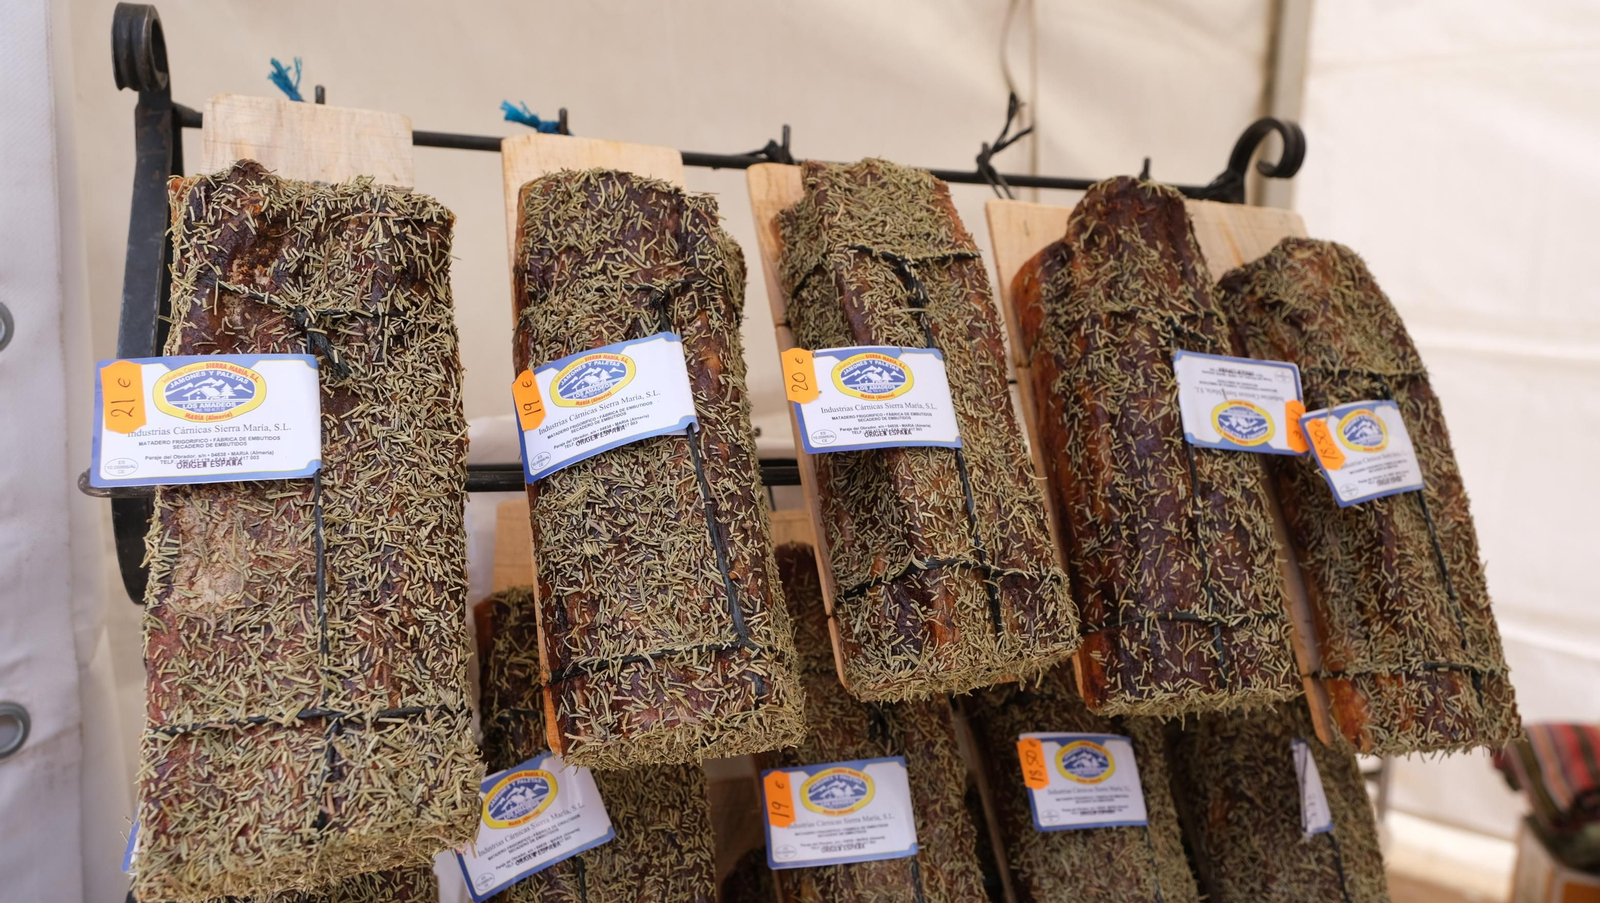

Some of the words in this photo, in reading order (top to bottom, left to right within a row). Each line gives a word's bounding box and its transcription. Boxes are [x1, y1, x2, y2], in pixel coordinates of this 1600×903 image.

[560, 363, 587, 386] JAMONES
[843, 360, 868, 375] JAMONES
[874, 360, 899, 371] PALETAS
[170, 370, 206, 388] JAMONES
[217, 370, 249, 384] PALETAS
[792, 373, 808, 392] 20
[111, 399, 135, 417] 21
[522, 400, 542, 416] 19
[539, 418, 568, 435] Industrias
[569, 408, 597, 421] Cárnicas
[599, 401, 619, 411] Sierra
[621, 394, 644, 404] María,
[820, 405, 853, 414] Industrias
[173, 426, 212, 435] Cárnicas
[215, 425, 240, 433] Sierra
[243, 424, 271, 432] María,
[274, 423, 291, 431] S.L.
[547, 427, 569, 439] MATADERO
[626, 401, 653, 410] EMBUTIDOS
[571, 422, 594, 433] SECADERO
[601, 412, 626, 422] EMBUTIDOS
[770, 801, 790, 818] 19
[478, 840, 504, 857] Industrias
[505, 827, 530, 842] Cárnicas
[530, 817, 550, 829] Sierra
